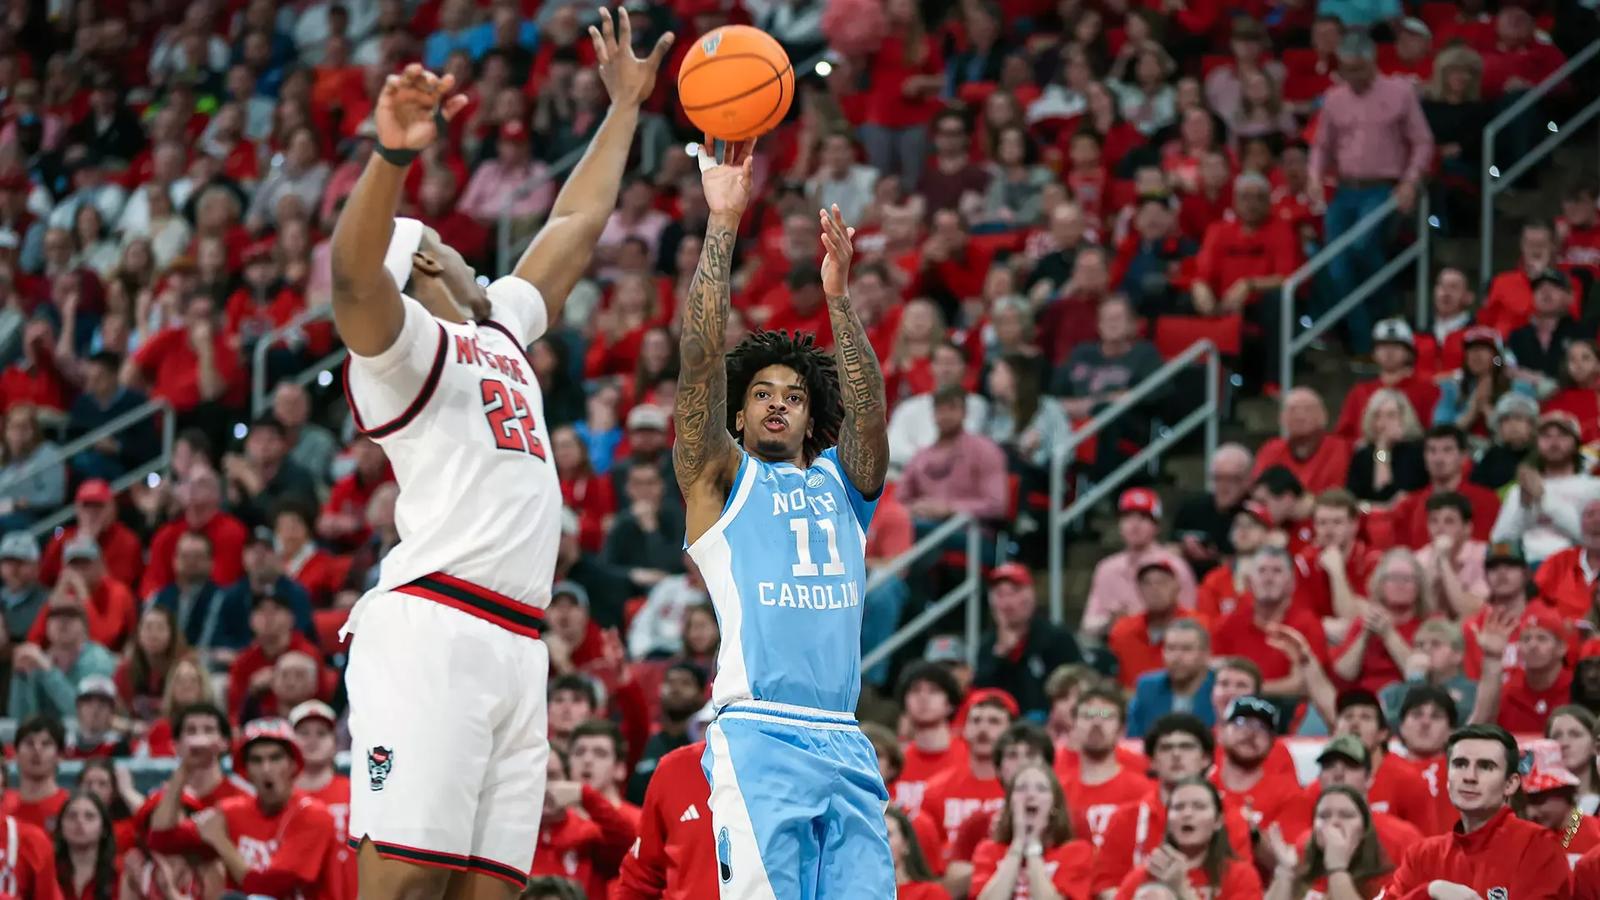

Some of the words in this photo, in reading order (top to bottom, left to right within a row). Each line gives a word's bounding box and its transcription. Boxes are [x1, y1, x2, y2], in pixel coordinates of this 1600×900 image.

[480, 378, 546, 463] 22
[772, 487, 839, 516] NOTH
[789, 517, 845, 577] 11
[758, 580, 859, 610] CAROLIN
